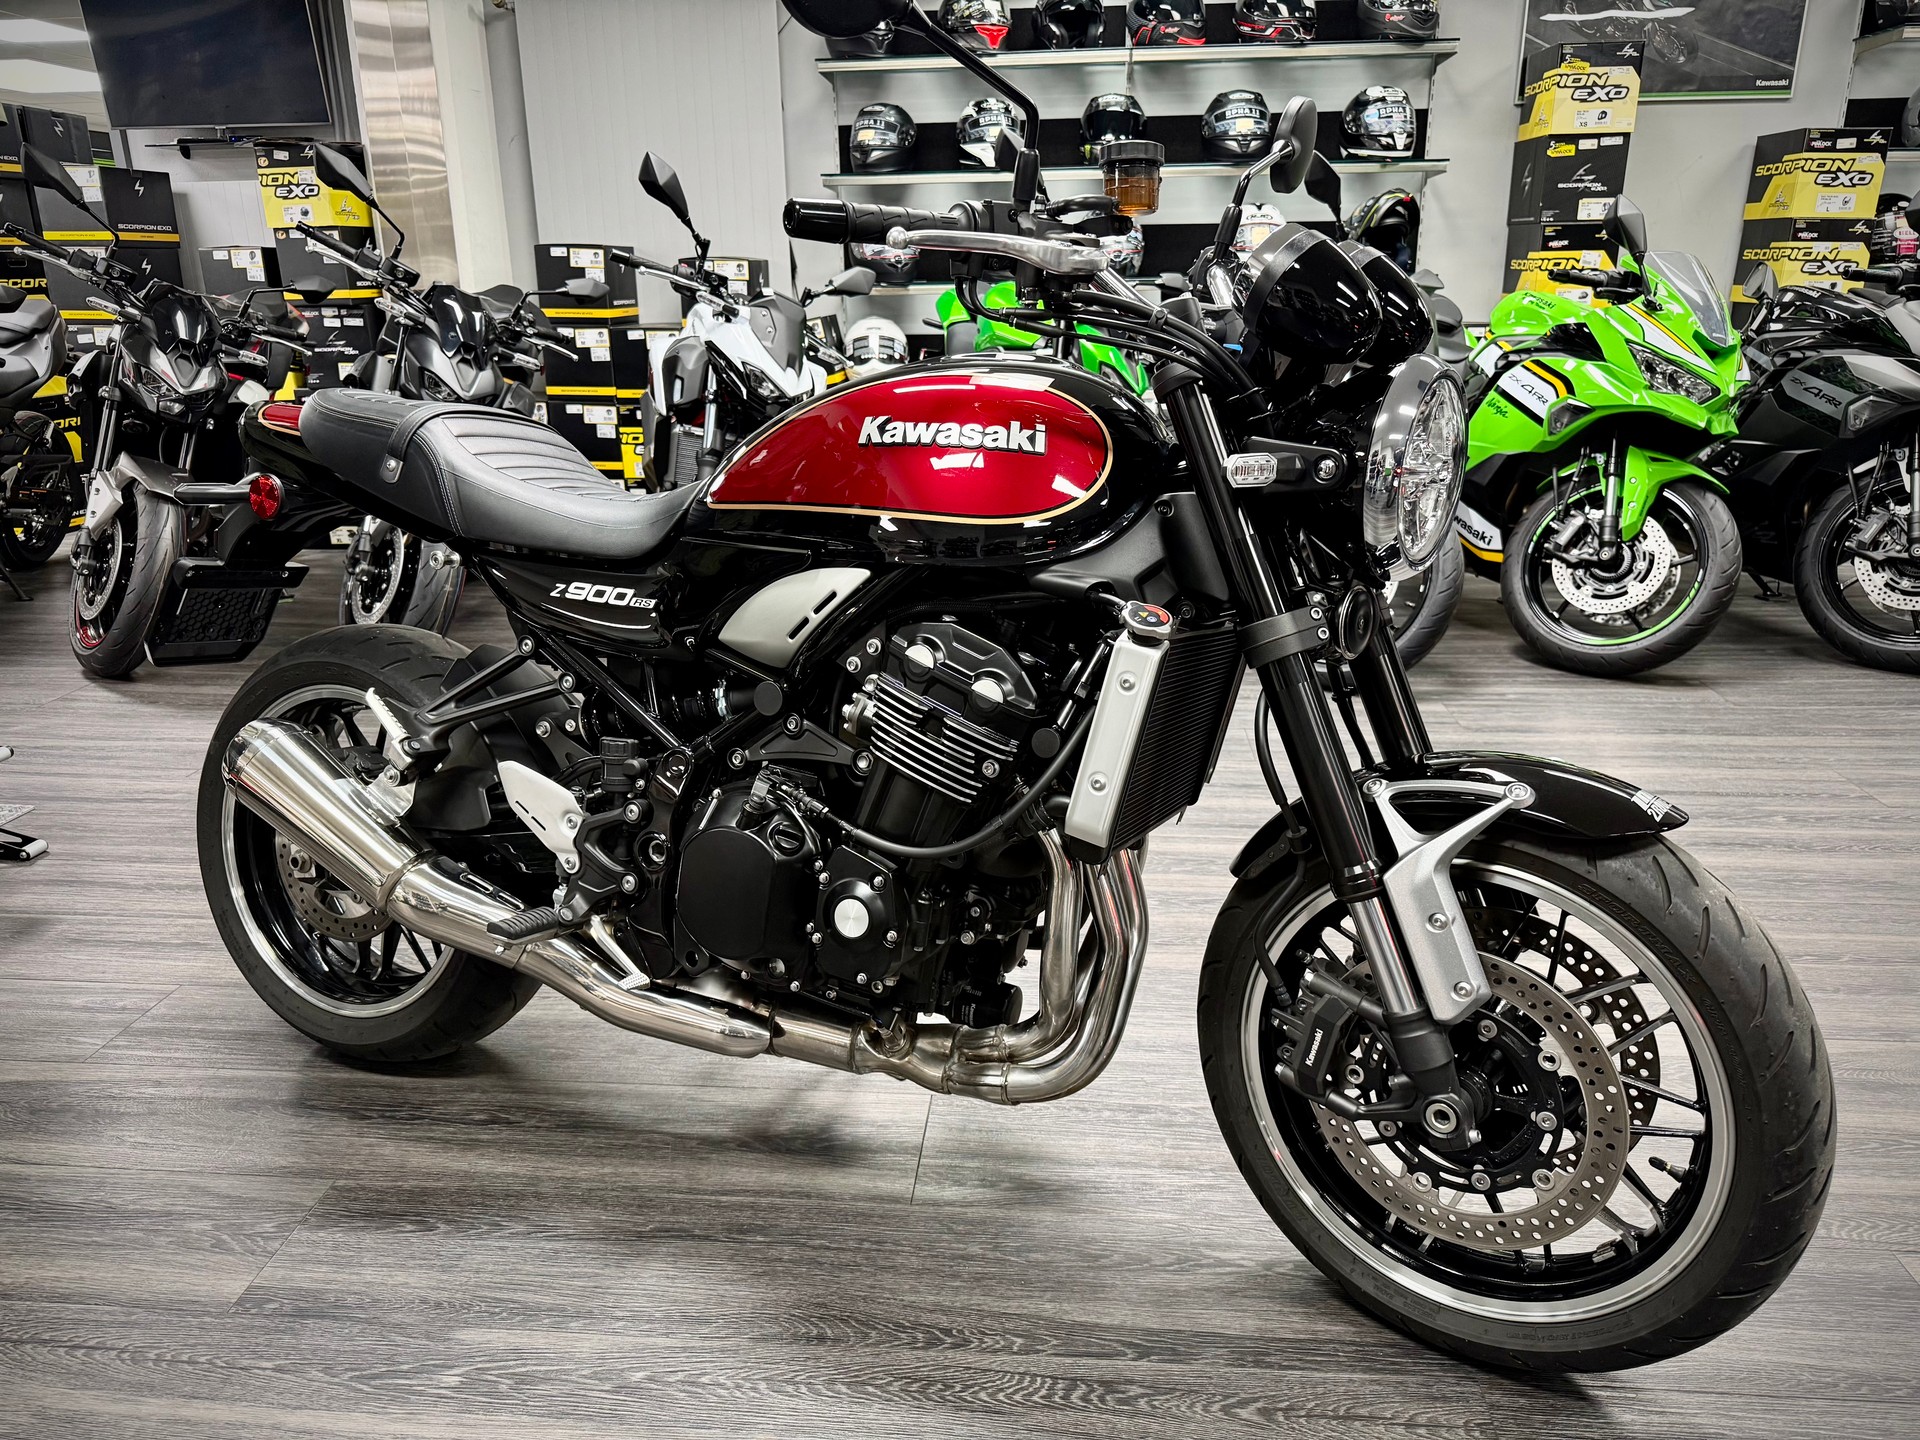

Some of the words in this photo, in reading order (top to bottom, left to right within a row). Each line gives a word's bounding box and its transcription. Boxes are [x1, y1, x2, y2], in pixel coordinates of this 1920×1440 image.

[1525, 73, 1608, 97] SCORPION
[1756, 79, 1789, 87] Kawasaki
[1380, 106, 1404, 115] RPHA
[1755, 158, 1855, 177] SCORPION
[118, 223, 157, 231] SCORPION
[1742, 247, 1839, 261] SCORPION
[1510, 258, 1582, 271] SCORPION
[858, 414, 1047, 455] Kawasaki
[1304, 1028, 1324, 1067] Kawasaki
